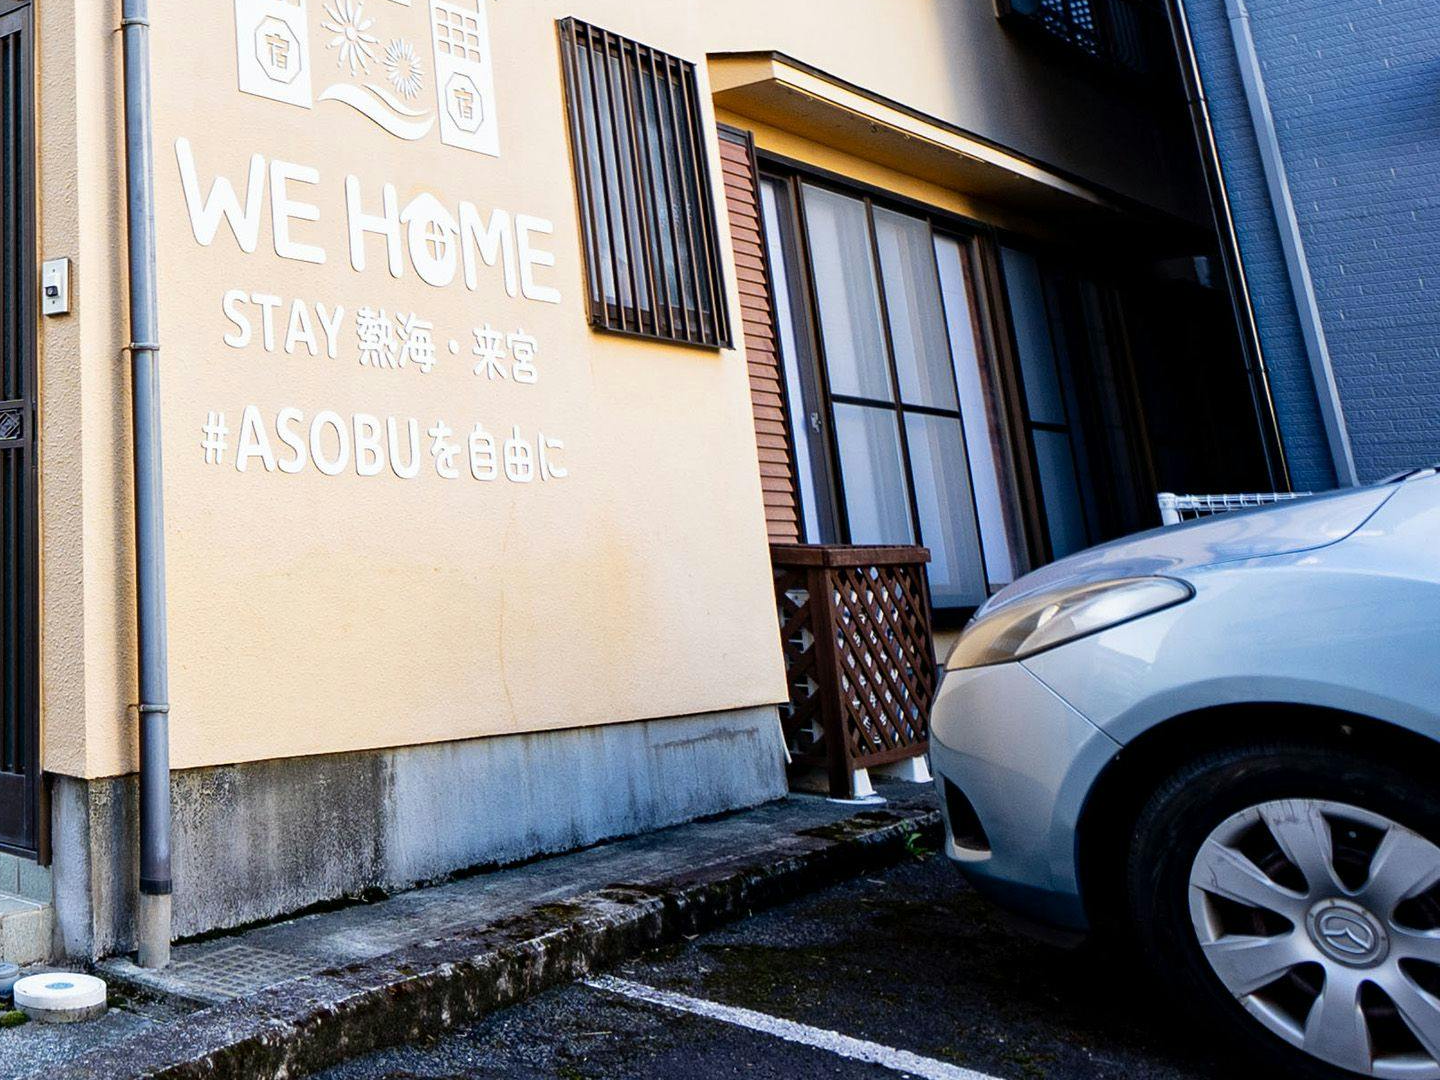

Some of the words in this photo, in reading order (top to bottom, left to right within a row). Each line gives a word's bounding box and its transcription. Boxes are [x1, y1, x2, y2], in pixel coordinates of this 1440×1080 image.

[264, 32, 290, 70] 宿
[174, 136, 327, 265] WE
[344, 173, 561, 304] HOME
[222, 289, 346, 360] STAY
